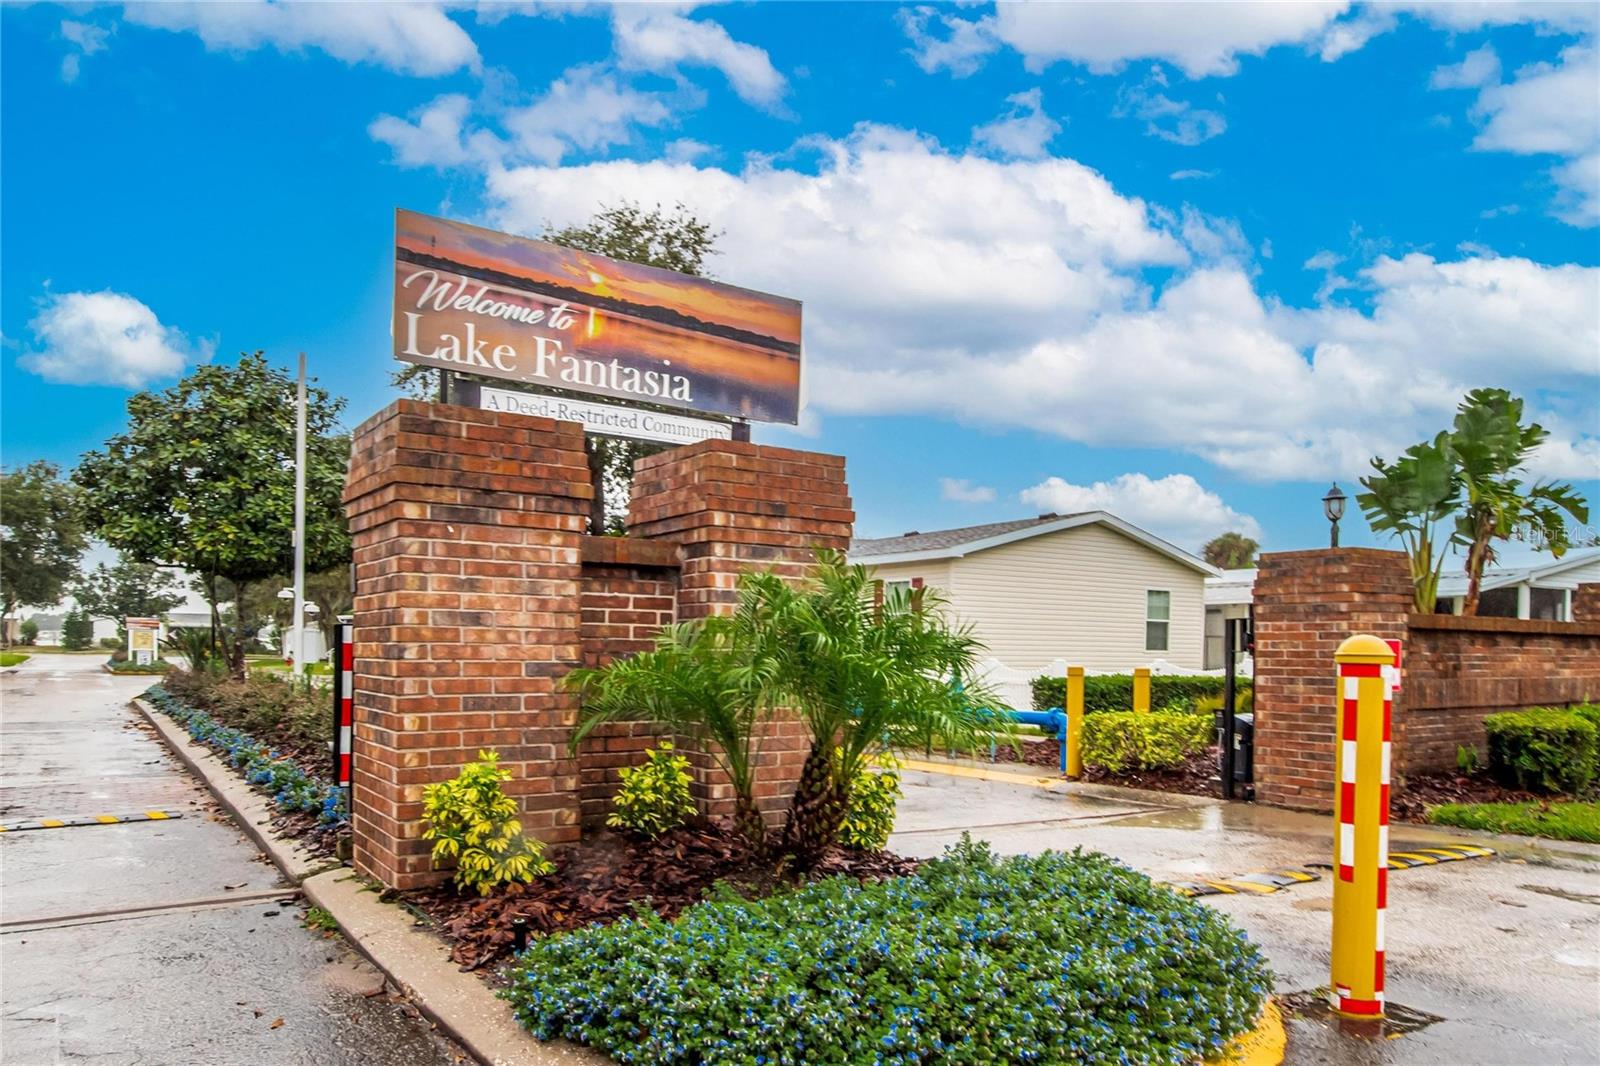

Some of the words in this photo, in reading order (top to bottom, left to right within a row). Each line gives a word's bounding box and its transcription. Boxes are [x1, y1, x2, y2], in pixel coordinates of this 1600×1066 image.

[402, 270, 546, 325] Welcome
[547, 303, 580, 330] to
[402, 311, 517, 372] Lake
[531, 336, 693, 402] Fantasia
[487, 395, 500, 410] A
[506, 396, 638, 429] Deed-Restricted
